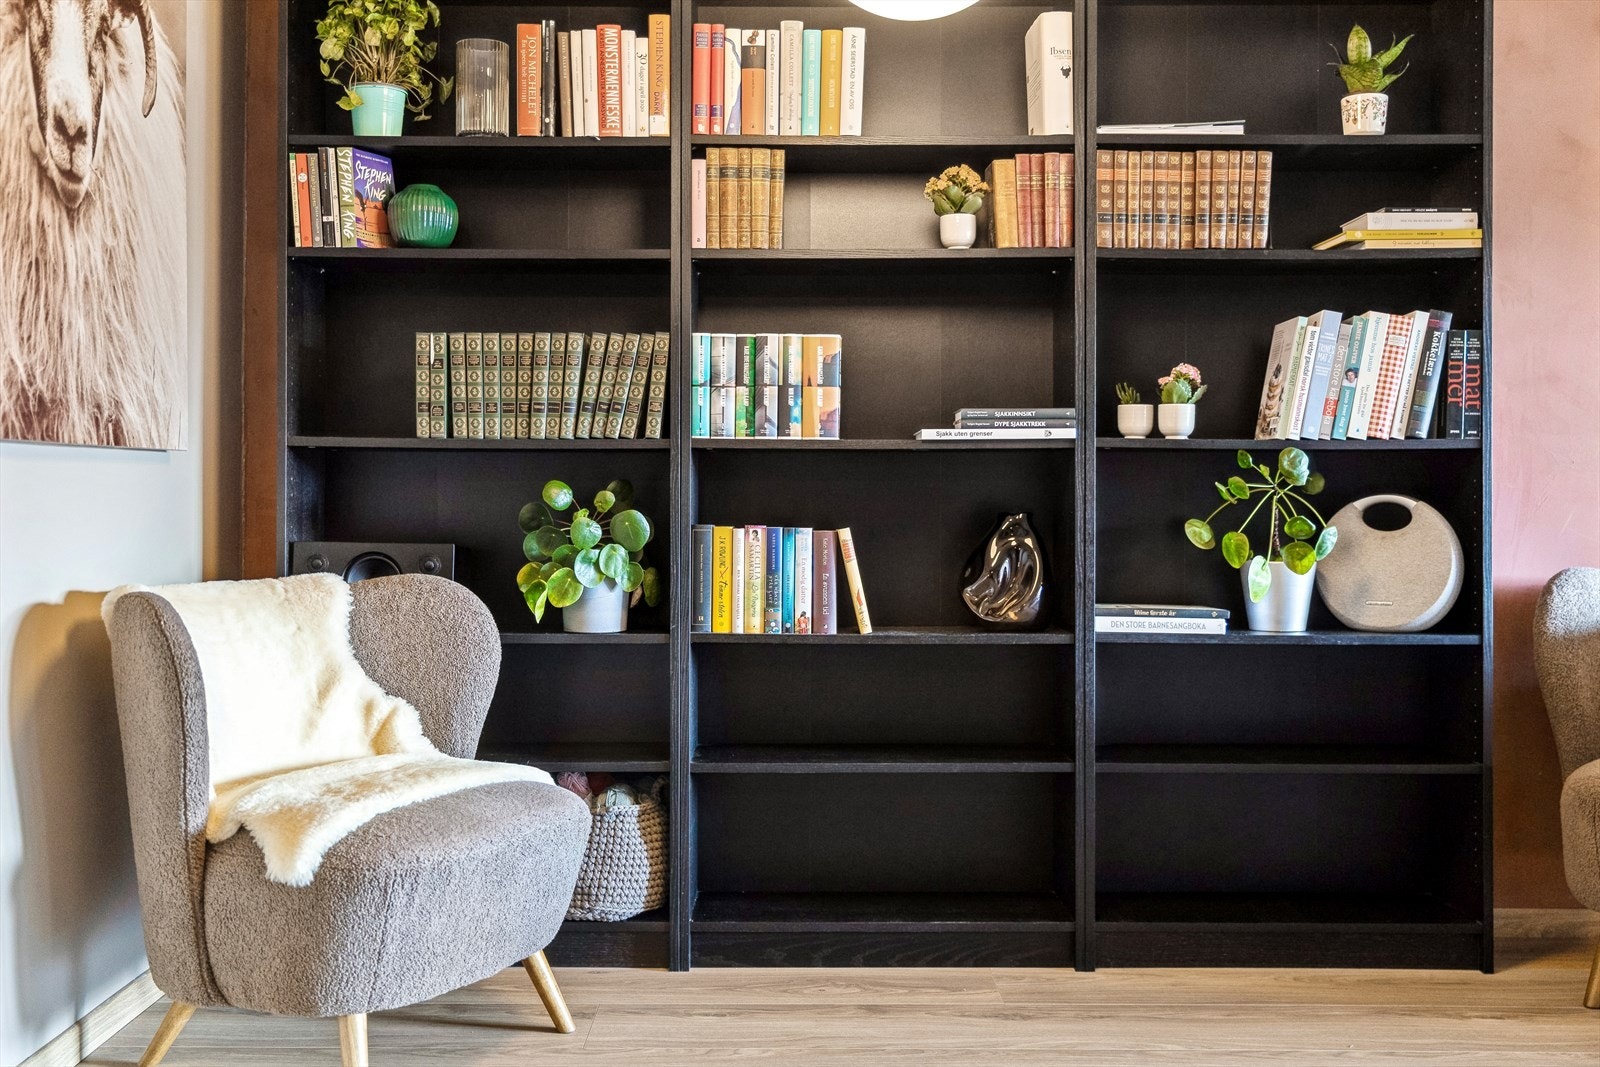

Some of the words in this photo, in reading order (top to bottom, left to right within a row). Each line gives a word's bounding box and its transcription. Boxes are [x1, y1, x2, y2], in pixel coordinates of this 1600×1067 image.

[526, 36, 537, 56] JON
[655, 20, 664, 62] STEPHEN
[1050, 47, 1072, 55] Ibsen
[636, 52, 648, 65] 30
[604, 28, 620, 128] MONSTERMENNESKE
[655, 64, 664, 88] KING
[850, 81, 855, 90] EN
[528, 61, 537, 116] MICHELET
[337, 149, 353, 202] STEPHEN
[354, 160, 392, 185] STEPHEN
[364, 179, 387, 202] KING
[341, 210, 356, 239] KING
[1308, 330, 1317, 341] tom
[1354, 321, 1363, 340] JAMIE
[1306, 341, 1316, 356] victor
[1336, 345, 1347, 361] den
[1350, 341, 1360, 364] OLIVER
[1370, 343, 1378, 354] hos
[1426, 331, 1441, 377] Kokkelære
[1302, 355, 1312, 377] gausdal
[1330, 363, 1342, 386] store
[1299, 376, 1308, 392] norsk
[1448, 360, 1464, 407] mer
[1465, 364, 1481, 409] mat
[1323, 387, 1339, 425] kakeboka
[1342, 389, 1350, 404] jamie
[1293, 392, 1306, 431] husmannskost
[1338, 416, 1346, 428] dag
[935, 430, 952, 438] Sjakk
[801, 557, 807, 565] En
[799, 565, 808, 585] modig
[1110, 620, 1124, 628] DEN
[1125, 621, 1146, 629] STORE
[1148, 621, 1206, 630] BARNESANGBOKA
